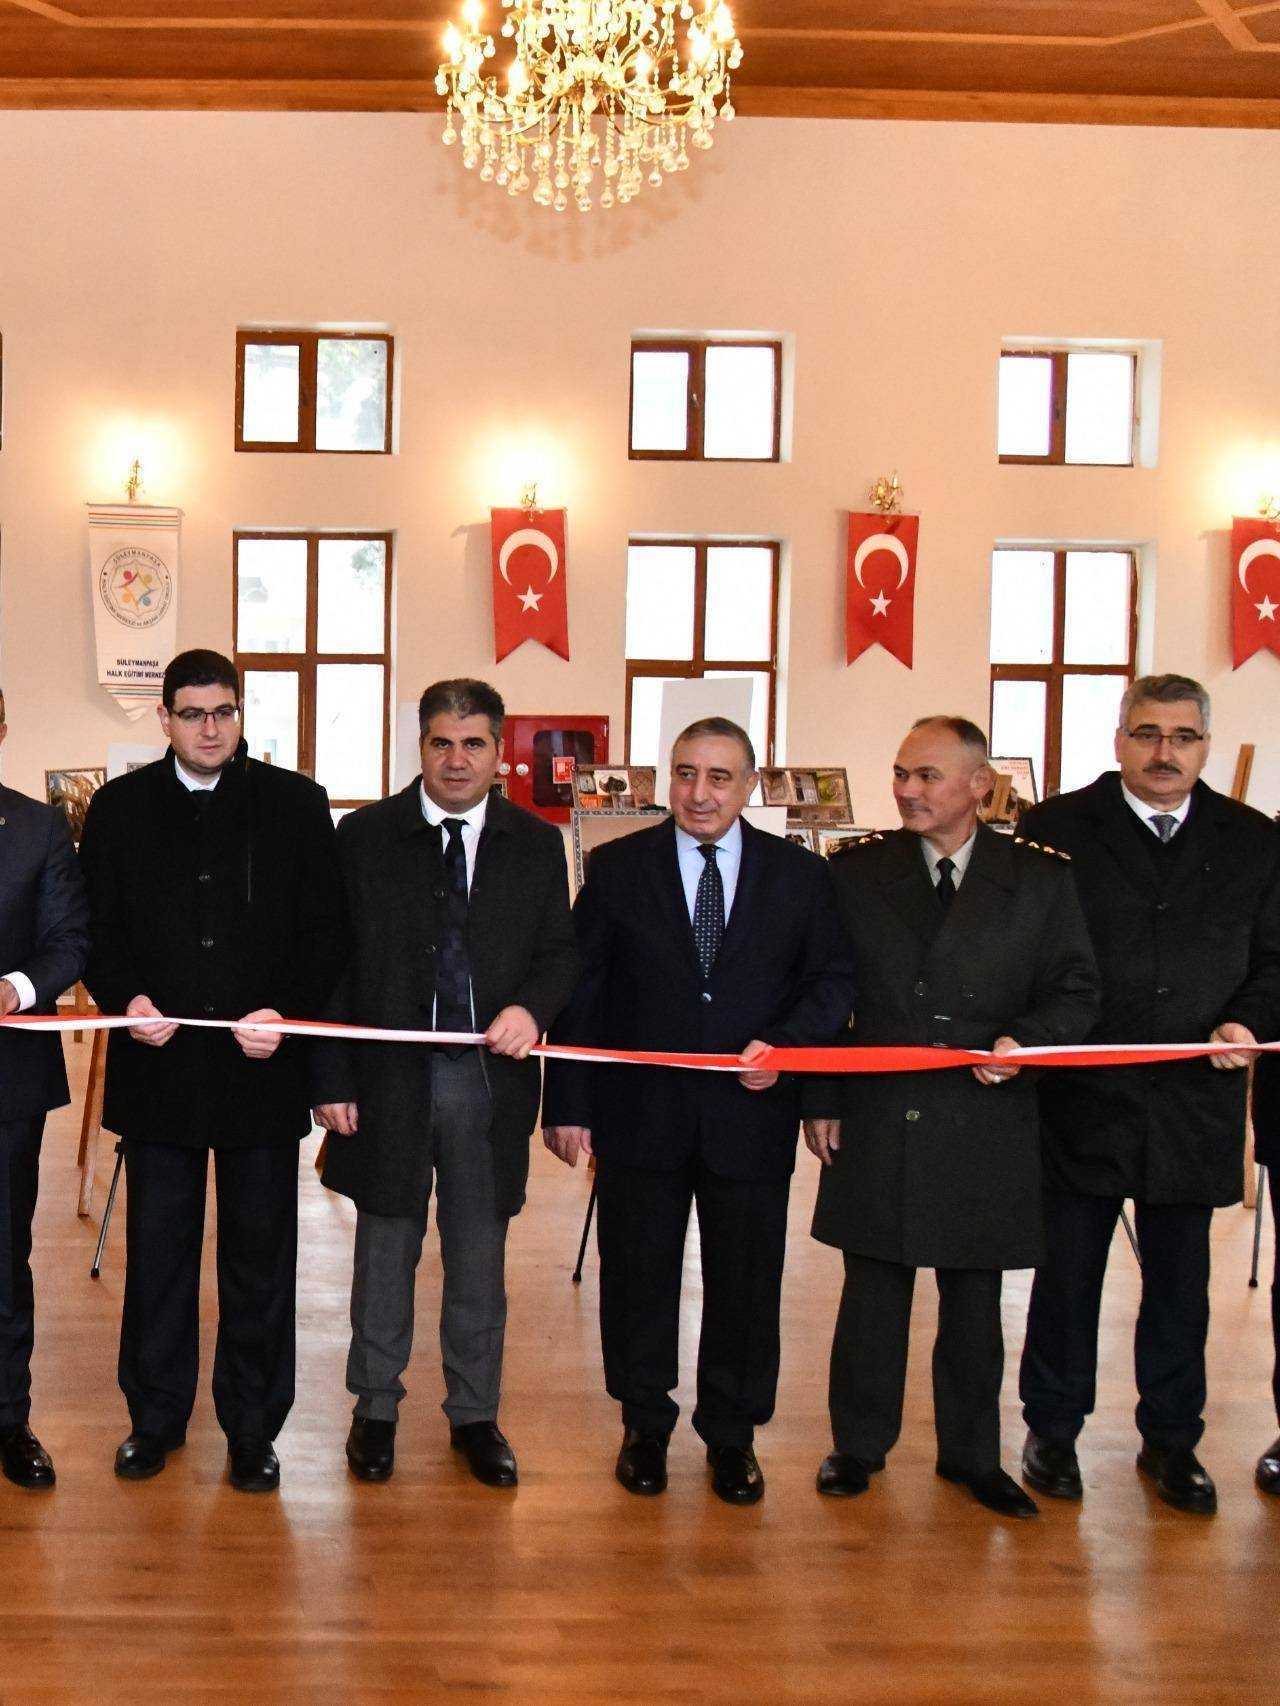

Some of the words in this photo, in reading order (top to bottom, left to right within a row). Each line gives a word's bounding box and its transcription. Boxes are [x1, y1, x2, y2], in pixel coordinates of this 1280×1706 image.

[116, 658, 159, 668] SÜLEYMANPAŞA
[124, 669, 144, 678] EĞİTİMİ
[145, 671, 166, 679] MERKEZ
